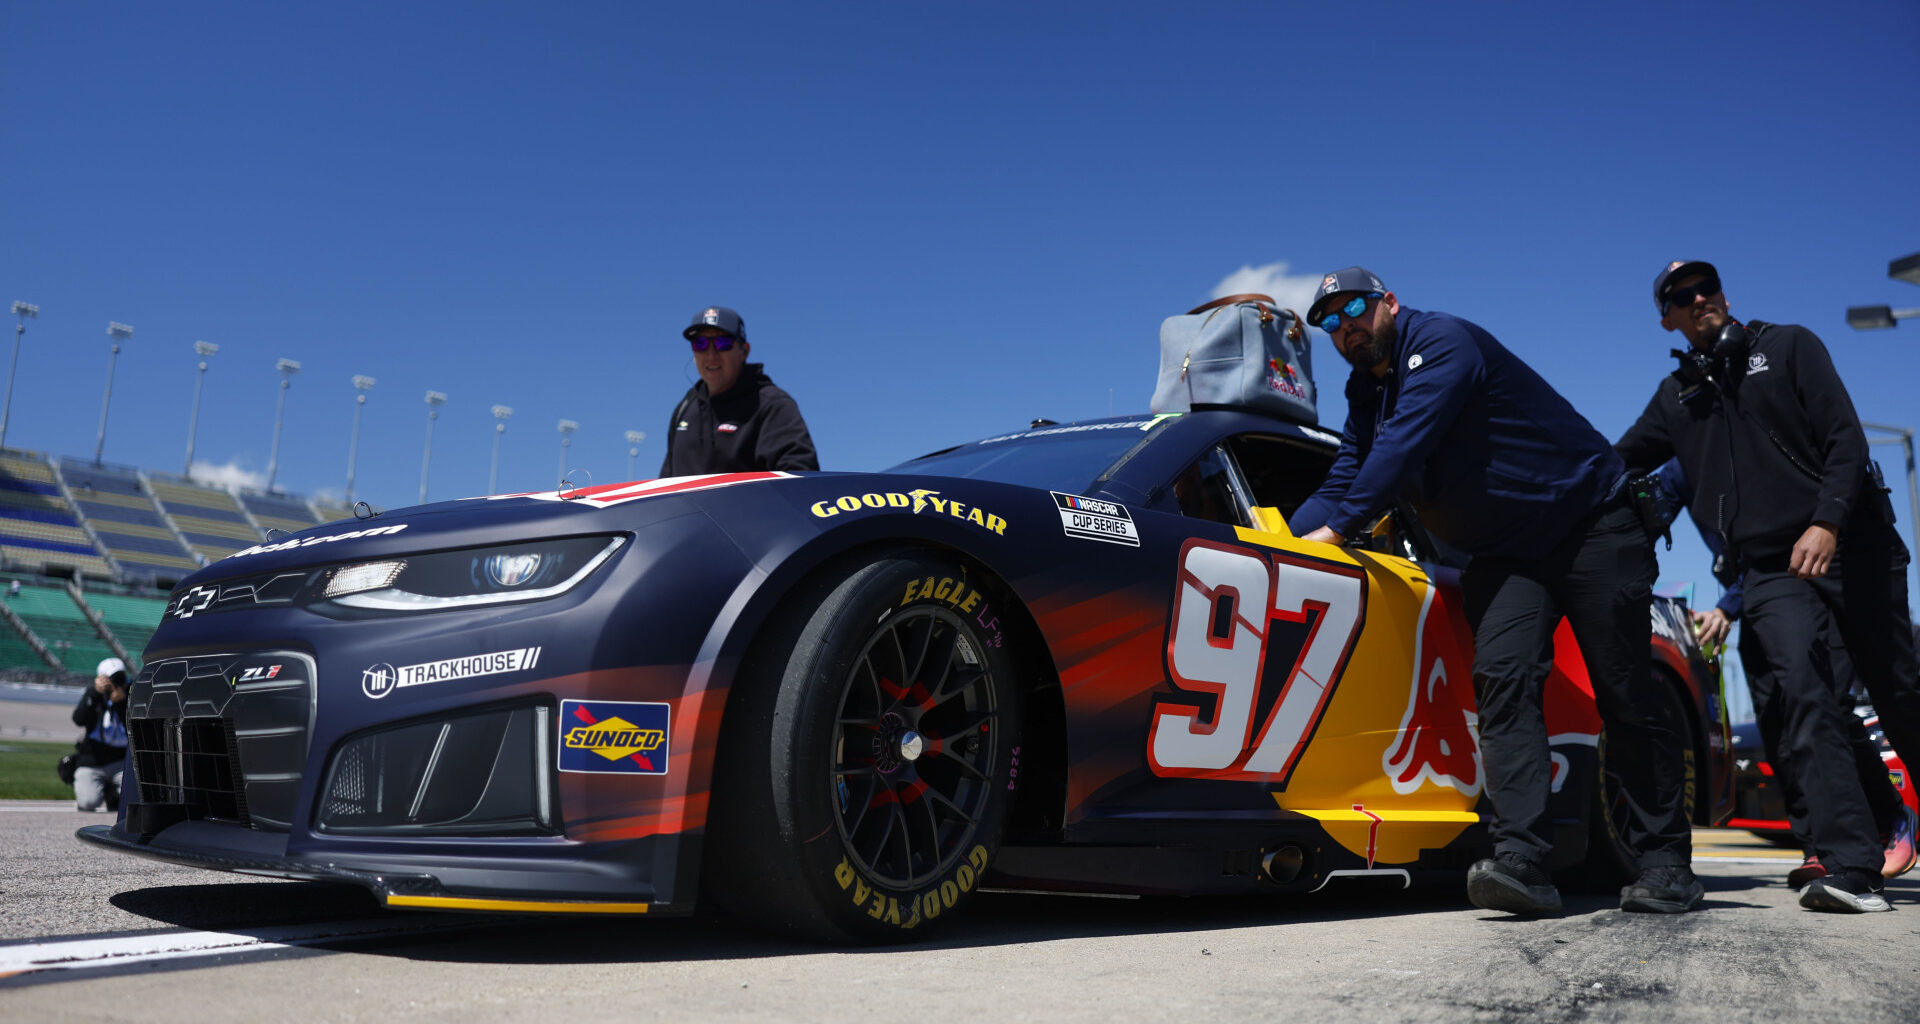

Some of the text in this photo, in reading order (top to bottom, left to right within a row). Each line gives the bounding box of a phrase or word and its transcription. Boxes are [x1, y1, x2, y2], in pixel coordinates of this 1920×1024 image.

[1078, 498, 1119, 516] NASCAR
[1072, 514, 1127, 534] CUP SERIES
[901, 576, 982, 613] EAGLE
[404, 652, 516, 684] TRACKHOUSE
[1149, 540, 1366, 779] 97
[238, 664, 282, 682] ZL1
[568, 729, 661, 748] SUNOCO
